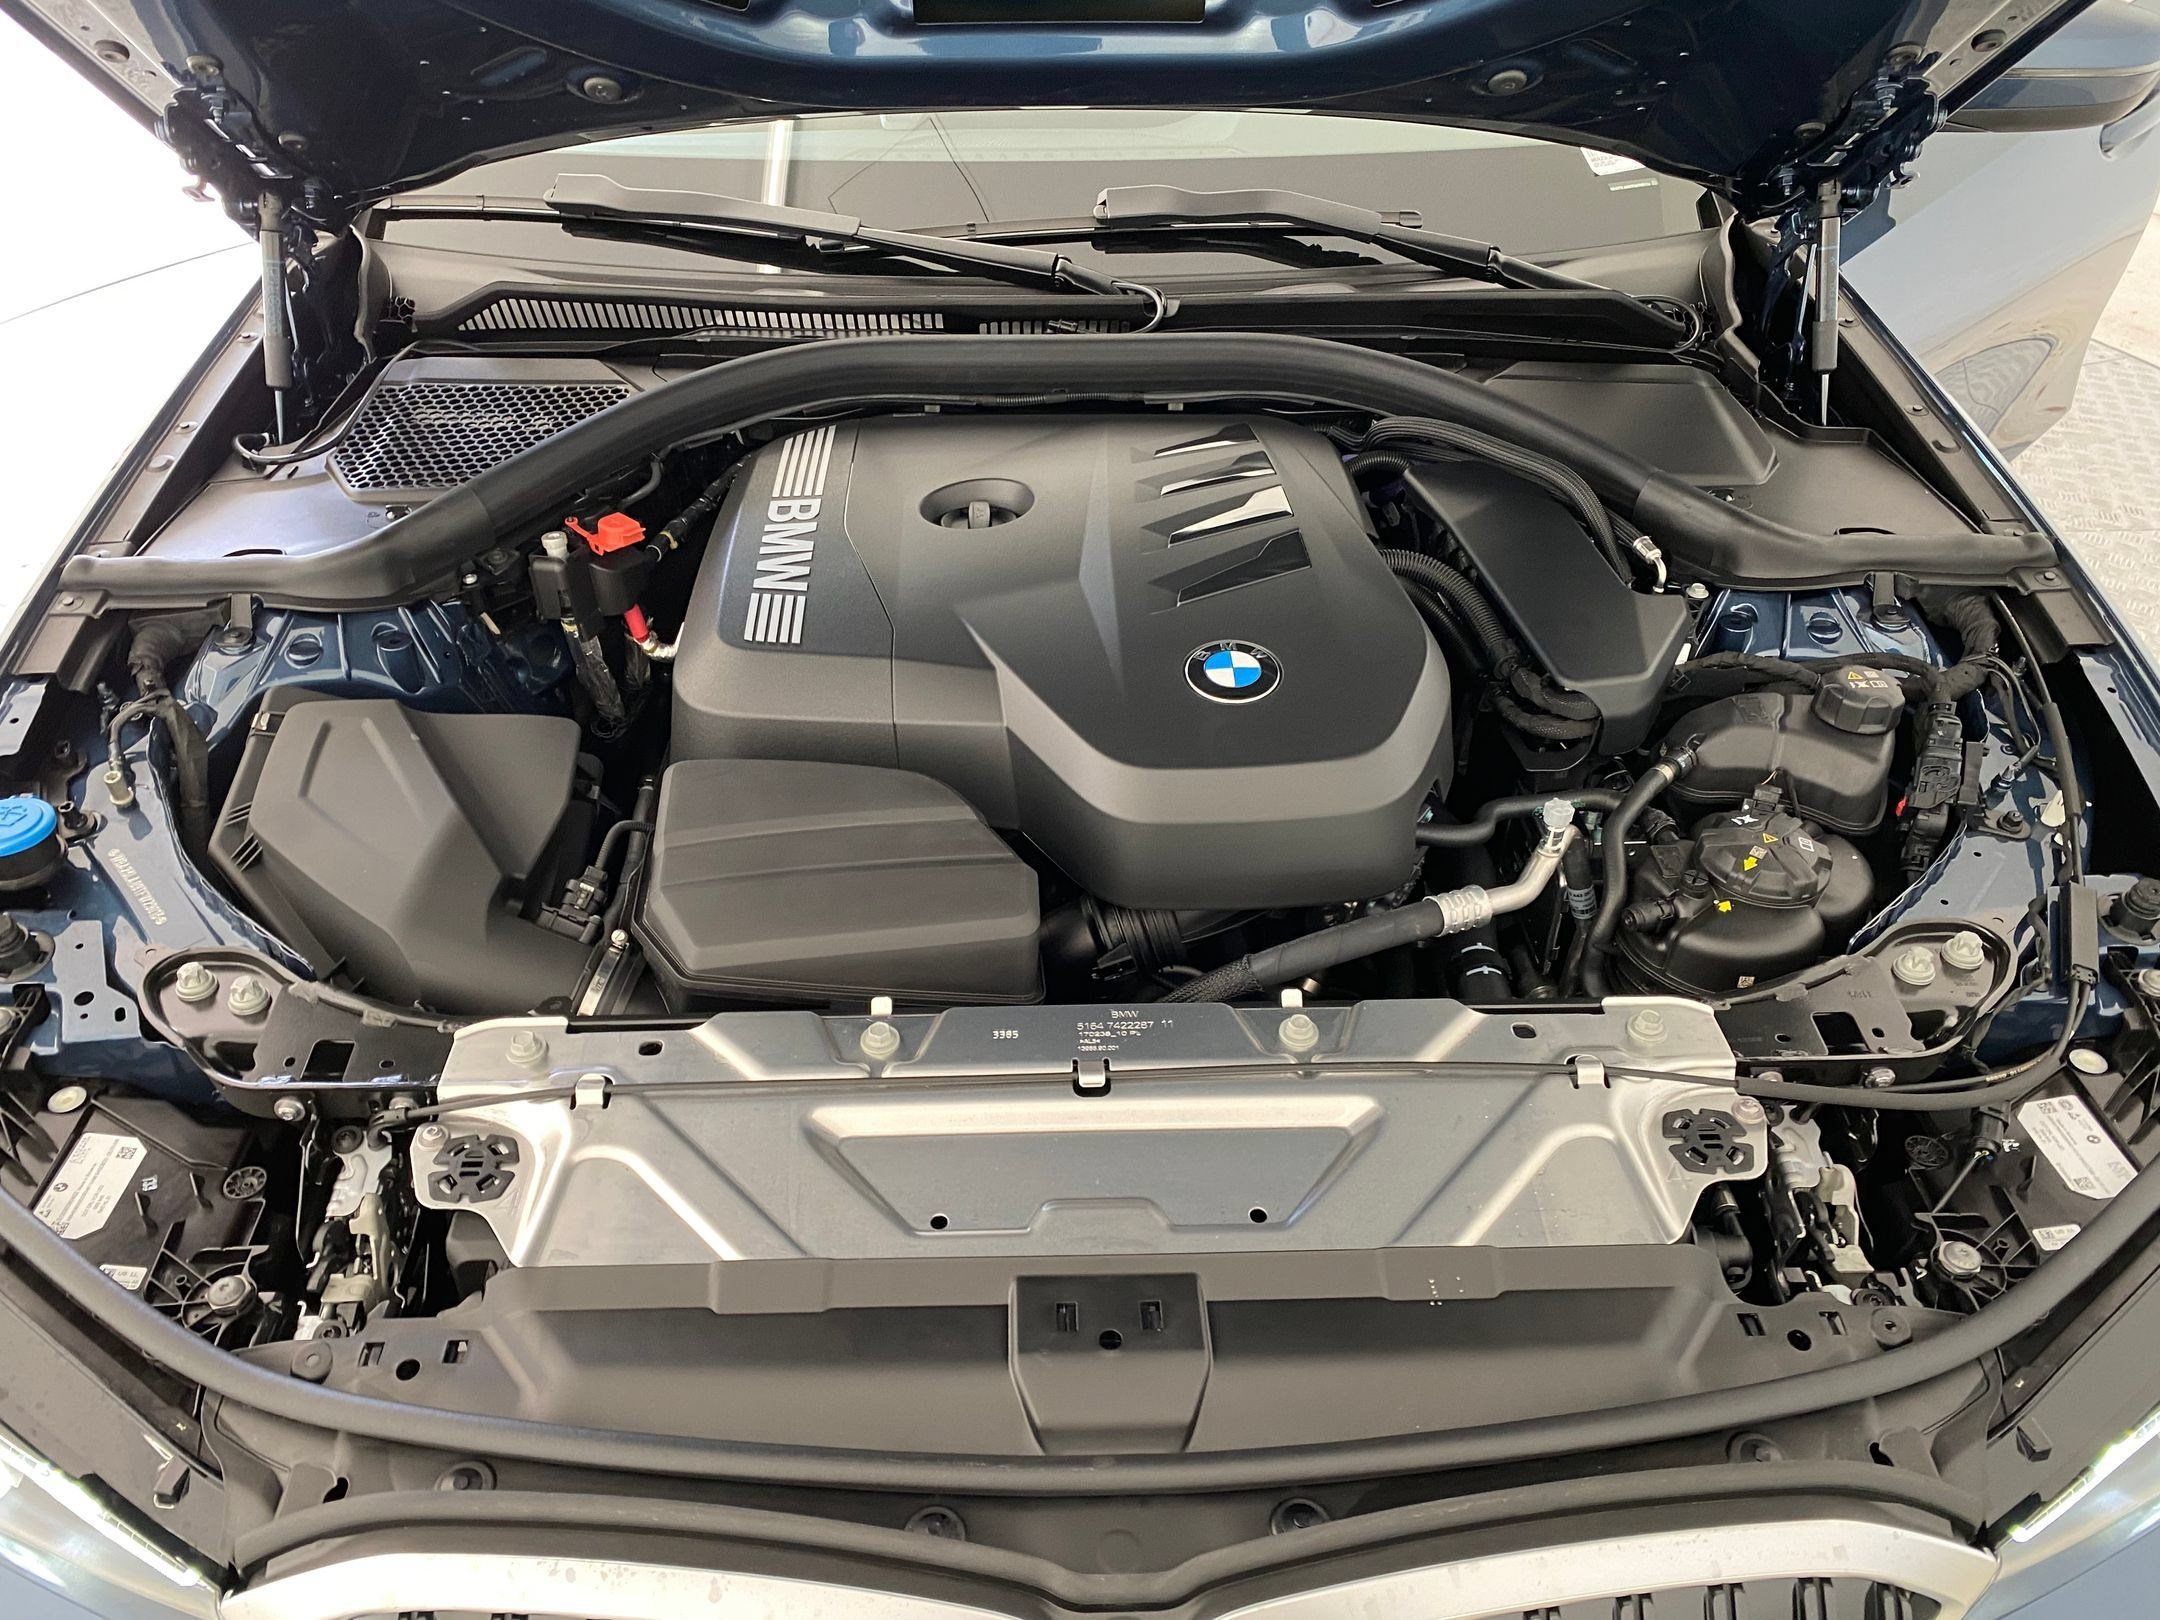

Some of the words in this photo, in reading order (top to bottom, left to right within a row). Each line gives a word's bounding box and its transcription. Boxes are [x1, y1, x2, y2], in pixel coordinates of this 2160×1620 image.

[753, 499, 821, 592] BMW
[1193, 640, 1268, 661] BMW
[1111, 1010, 1140, 1018] BMW
[1077, 1022, 1104, 1031] 5164
[1107, 1021, 1154, 1030] 7422287
[1161, 1019, 1174, 1028] 11
